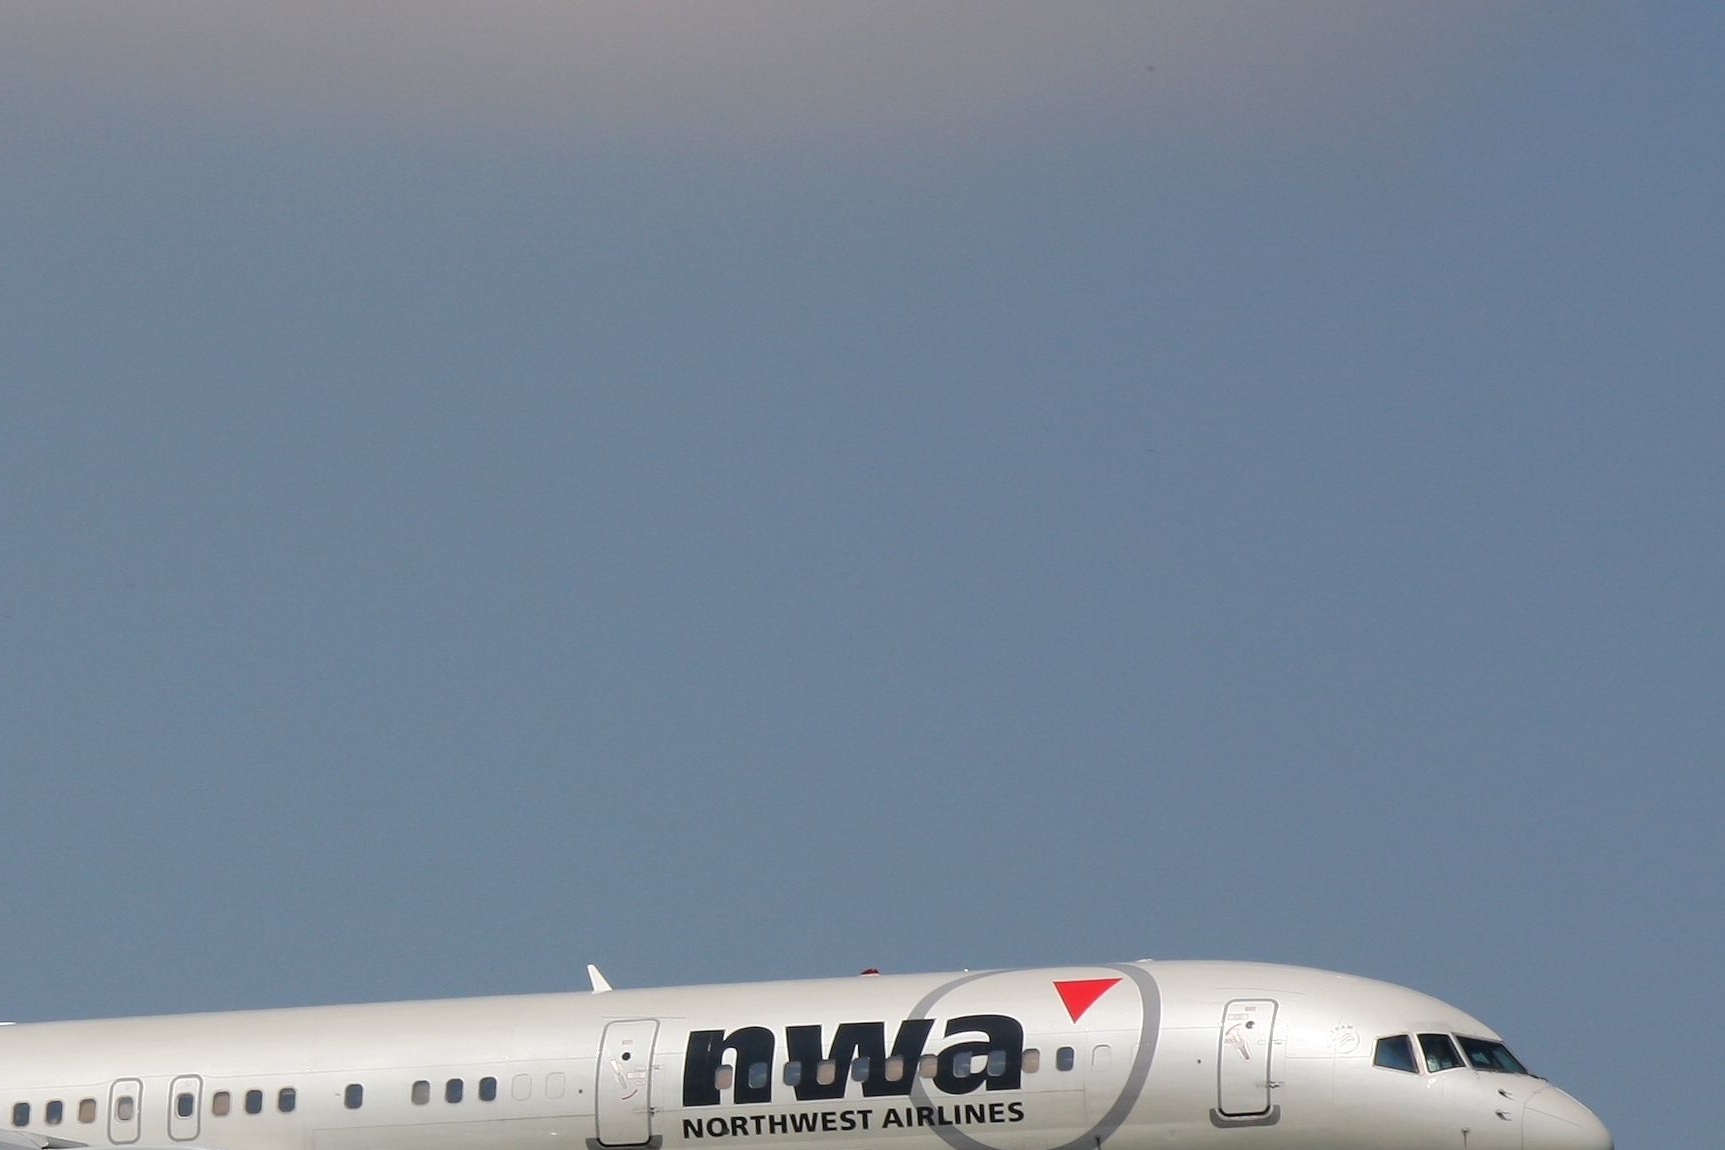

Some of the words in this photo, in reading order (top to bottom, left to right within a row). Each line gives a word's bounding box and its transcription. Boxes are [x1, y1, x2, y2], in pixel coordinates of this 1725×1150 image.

[683, 1014, 1024, 1107] nwa
[683, 1109, 873, 1139] NORTHWEST
[881, 1101, 1025, 1129] AIRLINES
